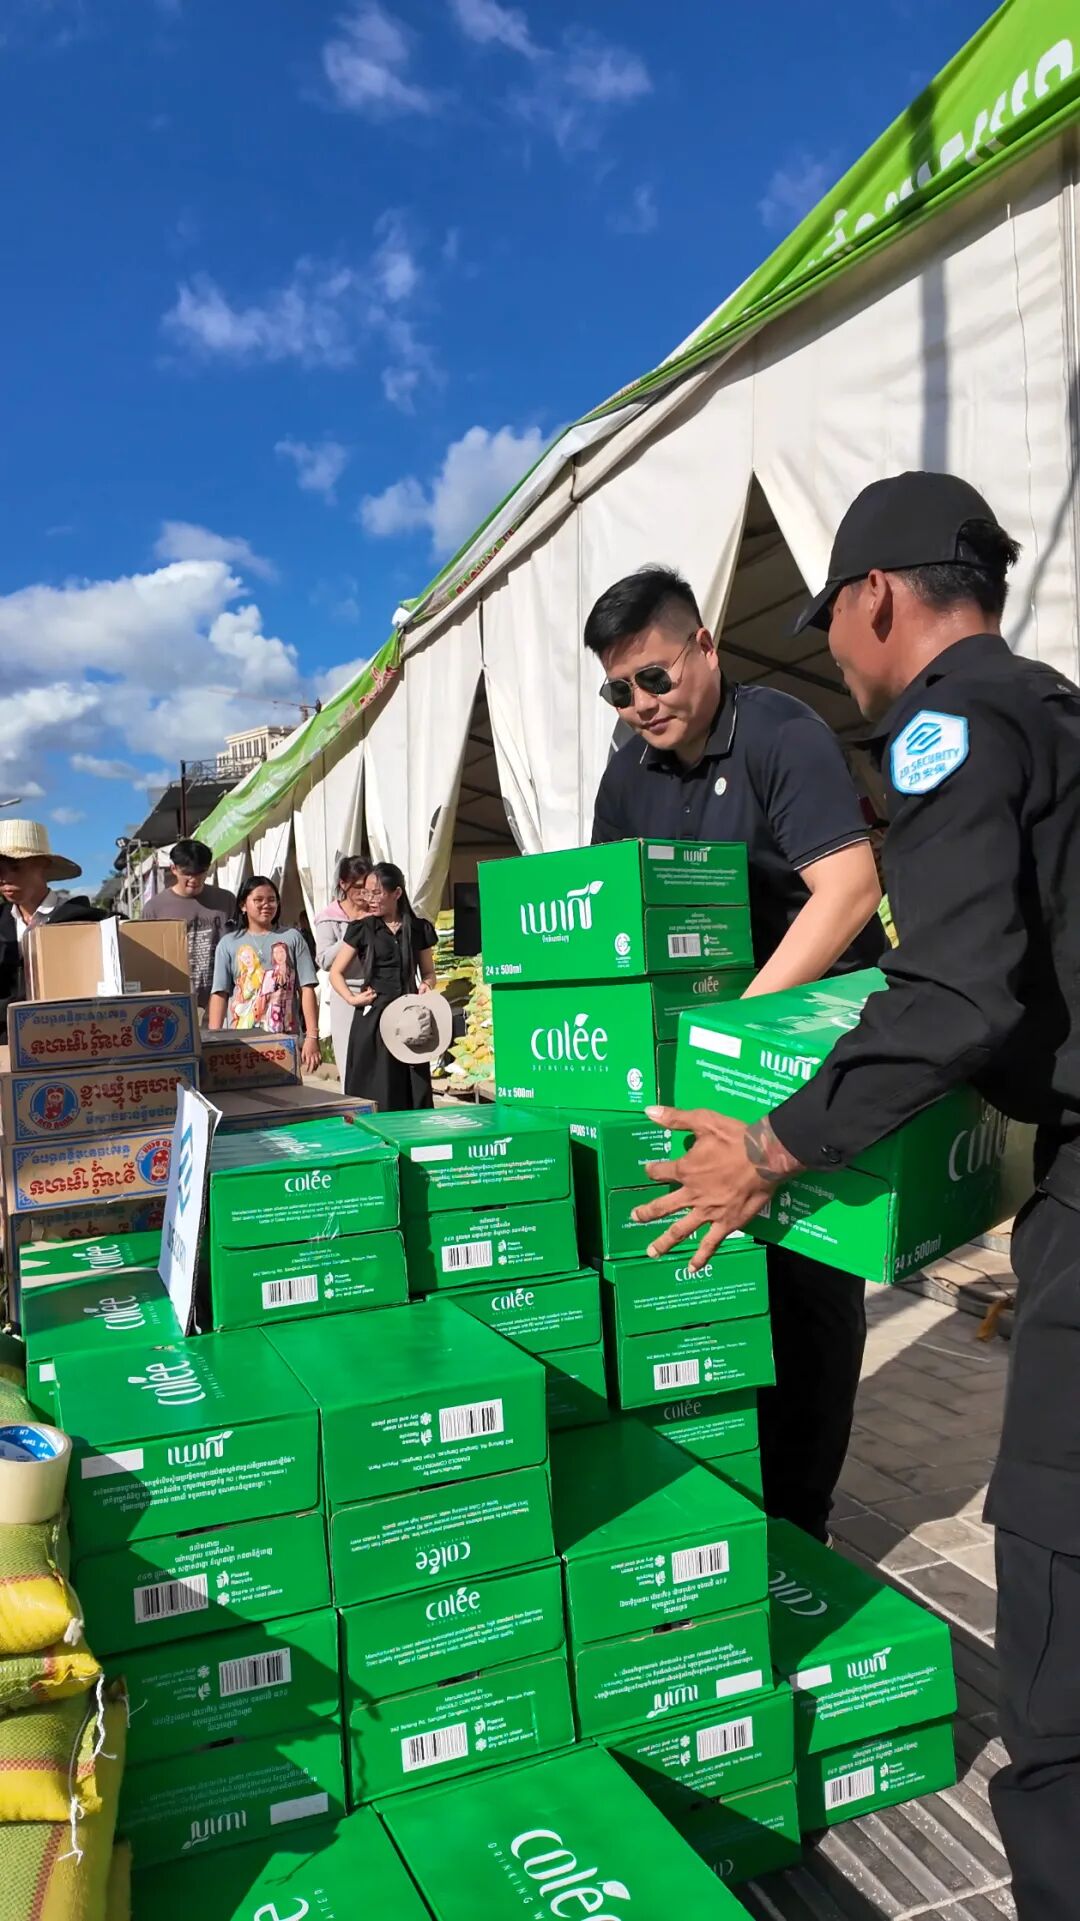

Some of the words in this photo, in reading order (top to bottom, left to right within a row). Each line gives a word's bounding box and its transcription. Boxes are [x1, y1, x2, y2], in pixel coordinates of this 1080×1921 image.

[911, 748, 960, 771] SECURITY
[486, 966, 494, 976] 24
[500, 964, 522, 975] 500ml
[692, 976, 720, 994] colée
[531, 1013, 608, 1061] colée
[498, 1087, 506, 1097] 24
[513, 1088, 534, 1098] 500ml
[284, 1170, 332, 1192] colée
[915, 1234, 941, 1263] 500ml
[84, 1295, 146, 1330] colée
[491, 1288, 534, 1311] colée
[128, 1360, 206, 1405] colée
[416, 1542, 471, 1575] colée
[426, 1586, 481, 1620] colée
[487, 1842, 534, 1904] DRINKING
[510, 1829, 631, 1921] colé
